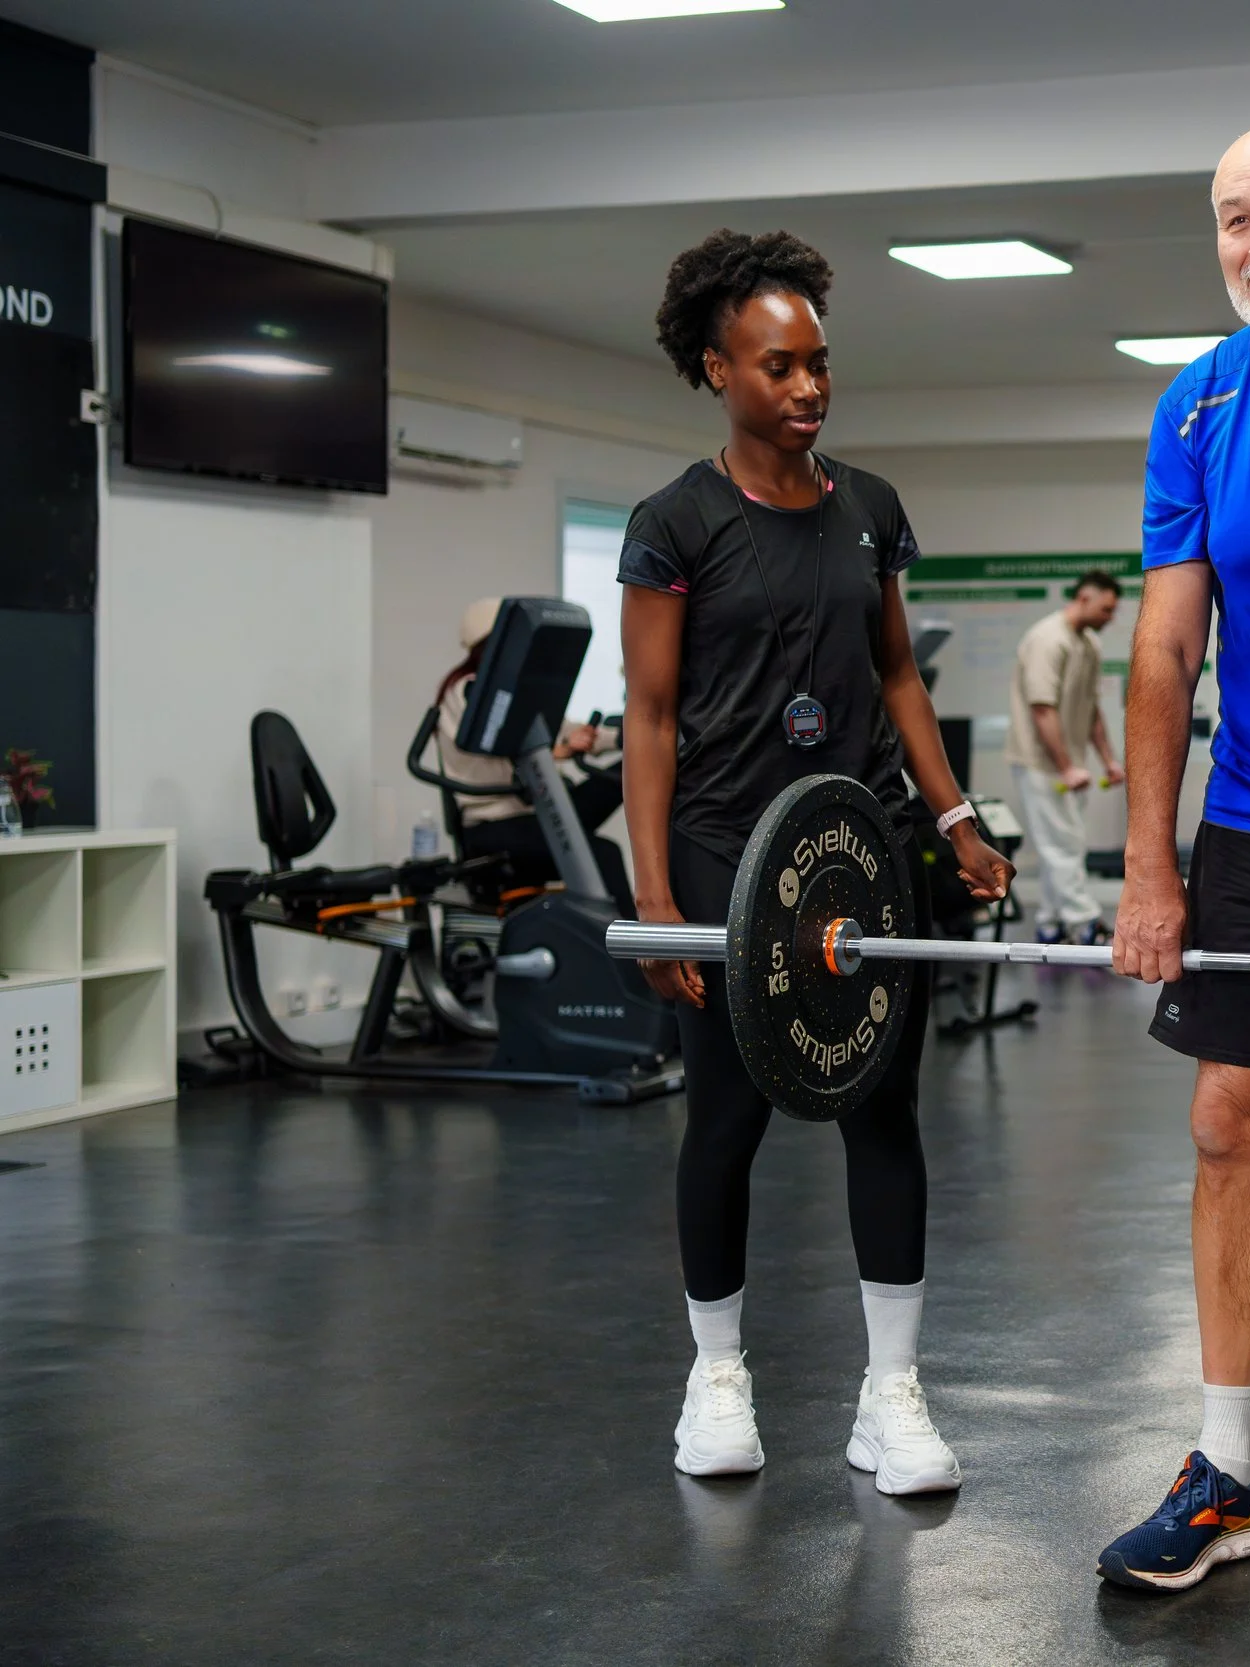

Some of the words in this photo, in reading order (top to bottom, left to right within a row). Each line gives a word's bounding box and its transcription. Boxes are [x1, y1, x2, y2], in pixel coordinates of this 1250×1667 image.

[0, 285, 54, 327] ND
[793, 820, 878, 881] Sveltus
[881, 904, 894, 931] 5
[771, 941, 784, 970] 5
[768, 970, 790, 997] KG
[558, 1004, 625, 1018] MATRIX
[790, 1016, 875, 1076] Sveltus
